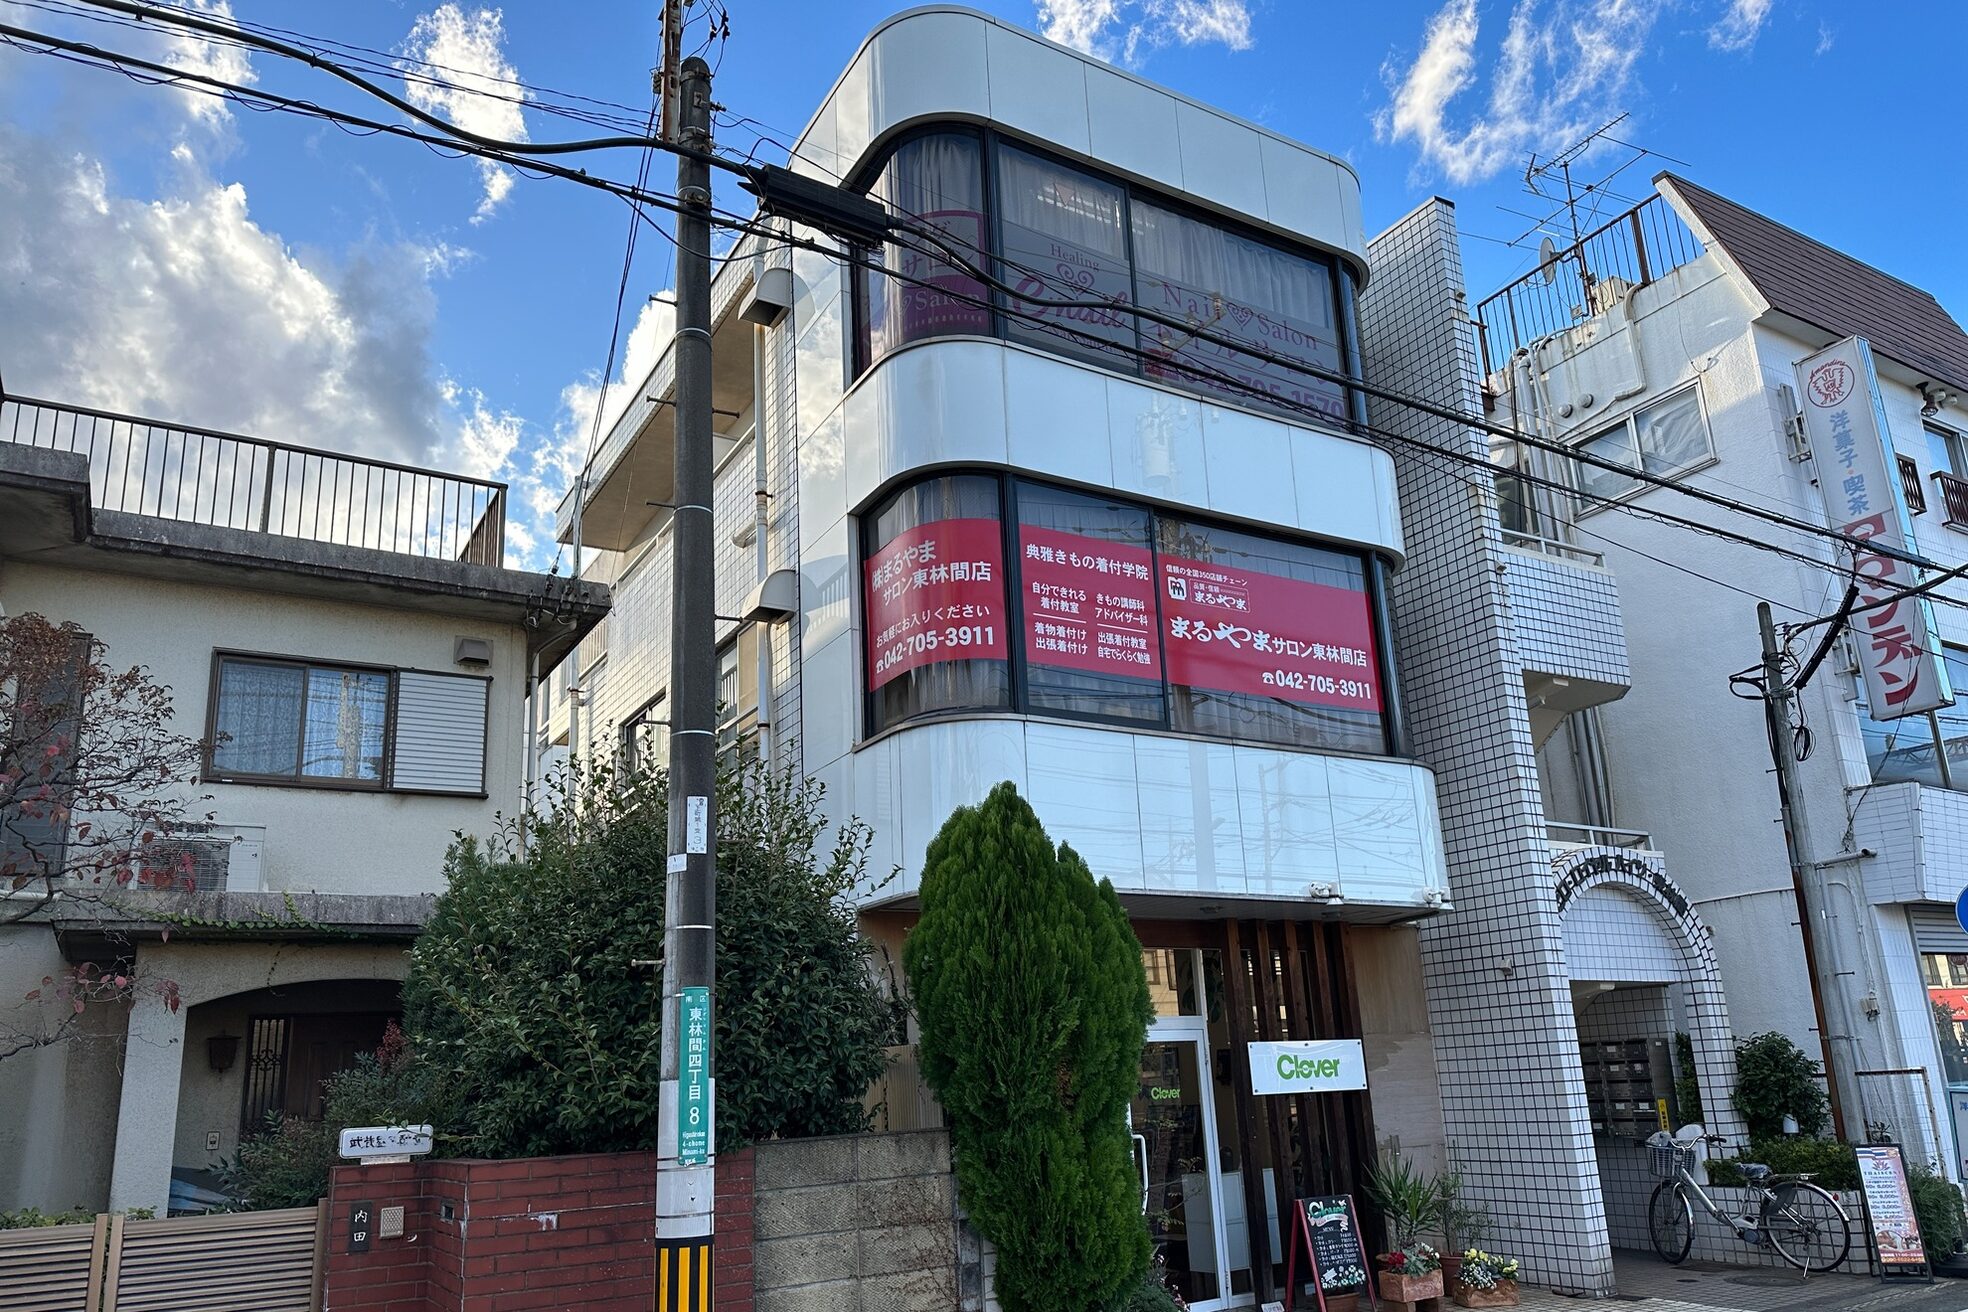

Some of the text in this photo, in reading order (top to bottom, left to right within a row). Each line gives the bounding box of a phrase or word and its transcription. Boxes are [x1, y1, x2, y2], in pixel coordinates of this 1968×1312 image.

[1050, 243, 1100, 272] Healing
[1163, 282, 1319, 350] Nai Salon
[1026, 543, 1149, 580] 典雅きもの着付学院
[883, 561, 992, 606] サロン東林間店
[1032, 581, 1087, 601] 自分できれる
[1040, 596, 1080, 614] 着付教室
[1096, 593, 1145, 612] きもの講師科
[1194, 591, 1247, 610] まるやま
[876, 604, 990, 648] お気軽にお入りください
[1095, 607, 1148, 626] アドバイザー科
[1034, 621, 1087, 640] 着物着付け
[1097, 631, 1148, 650] 出張着付教室
[884, 626, 994, 669] 042-705-3911
[1035, 636, 1088, 655] 出張着付け
[1097, 646, 1152, 664] 自宅でらくらく勉強
[1275, 669, 1371, 699] 042-705-3911
[688, 1006, 703, 1125] 東林間四丁目 8
[1277, 1055, 1340, 1080] Clover
[1308, 1200, 1347, 1219] Clover
[353, 1209, 368, 1242] 内田
